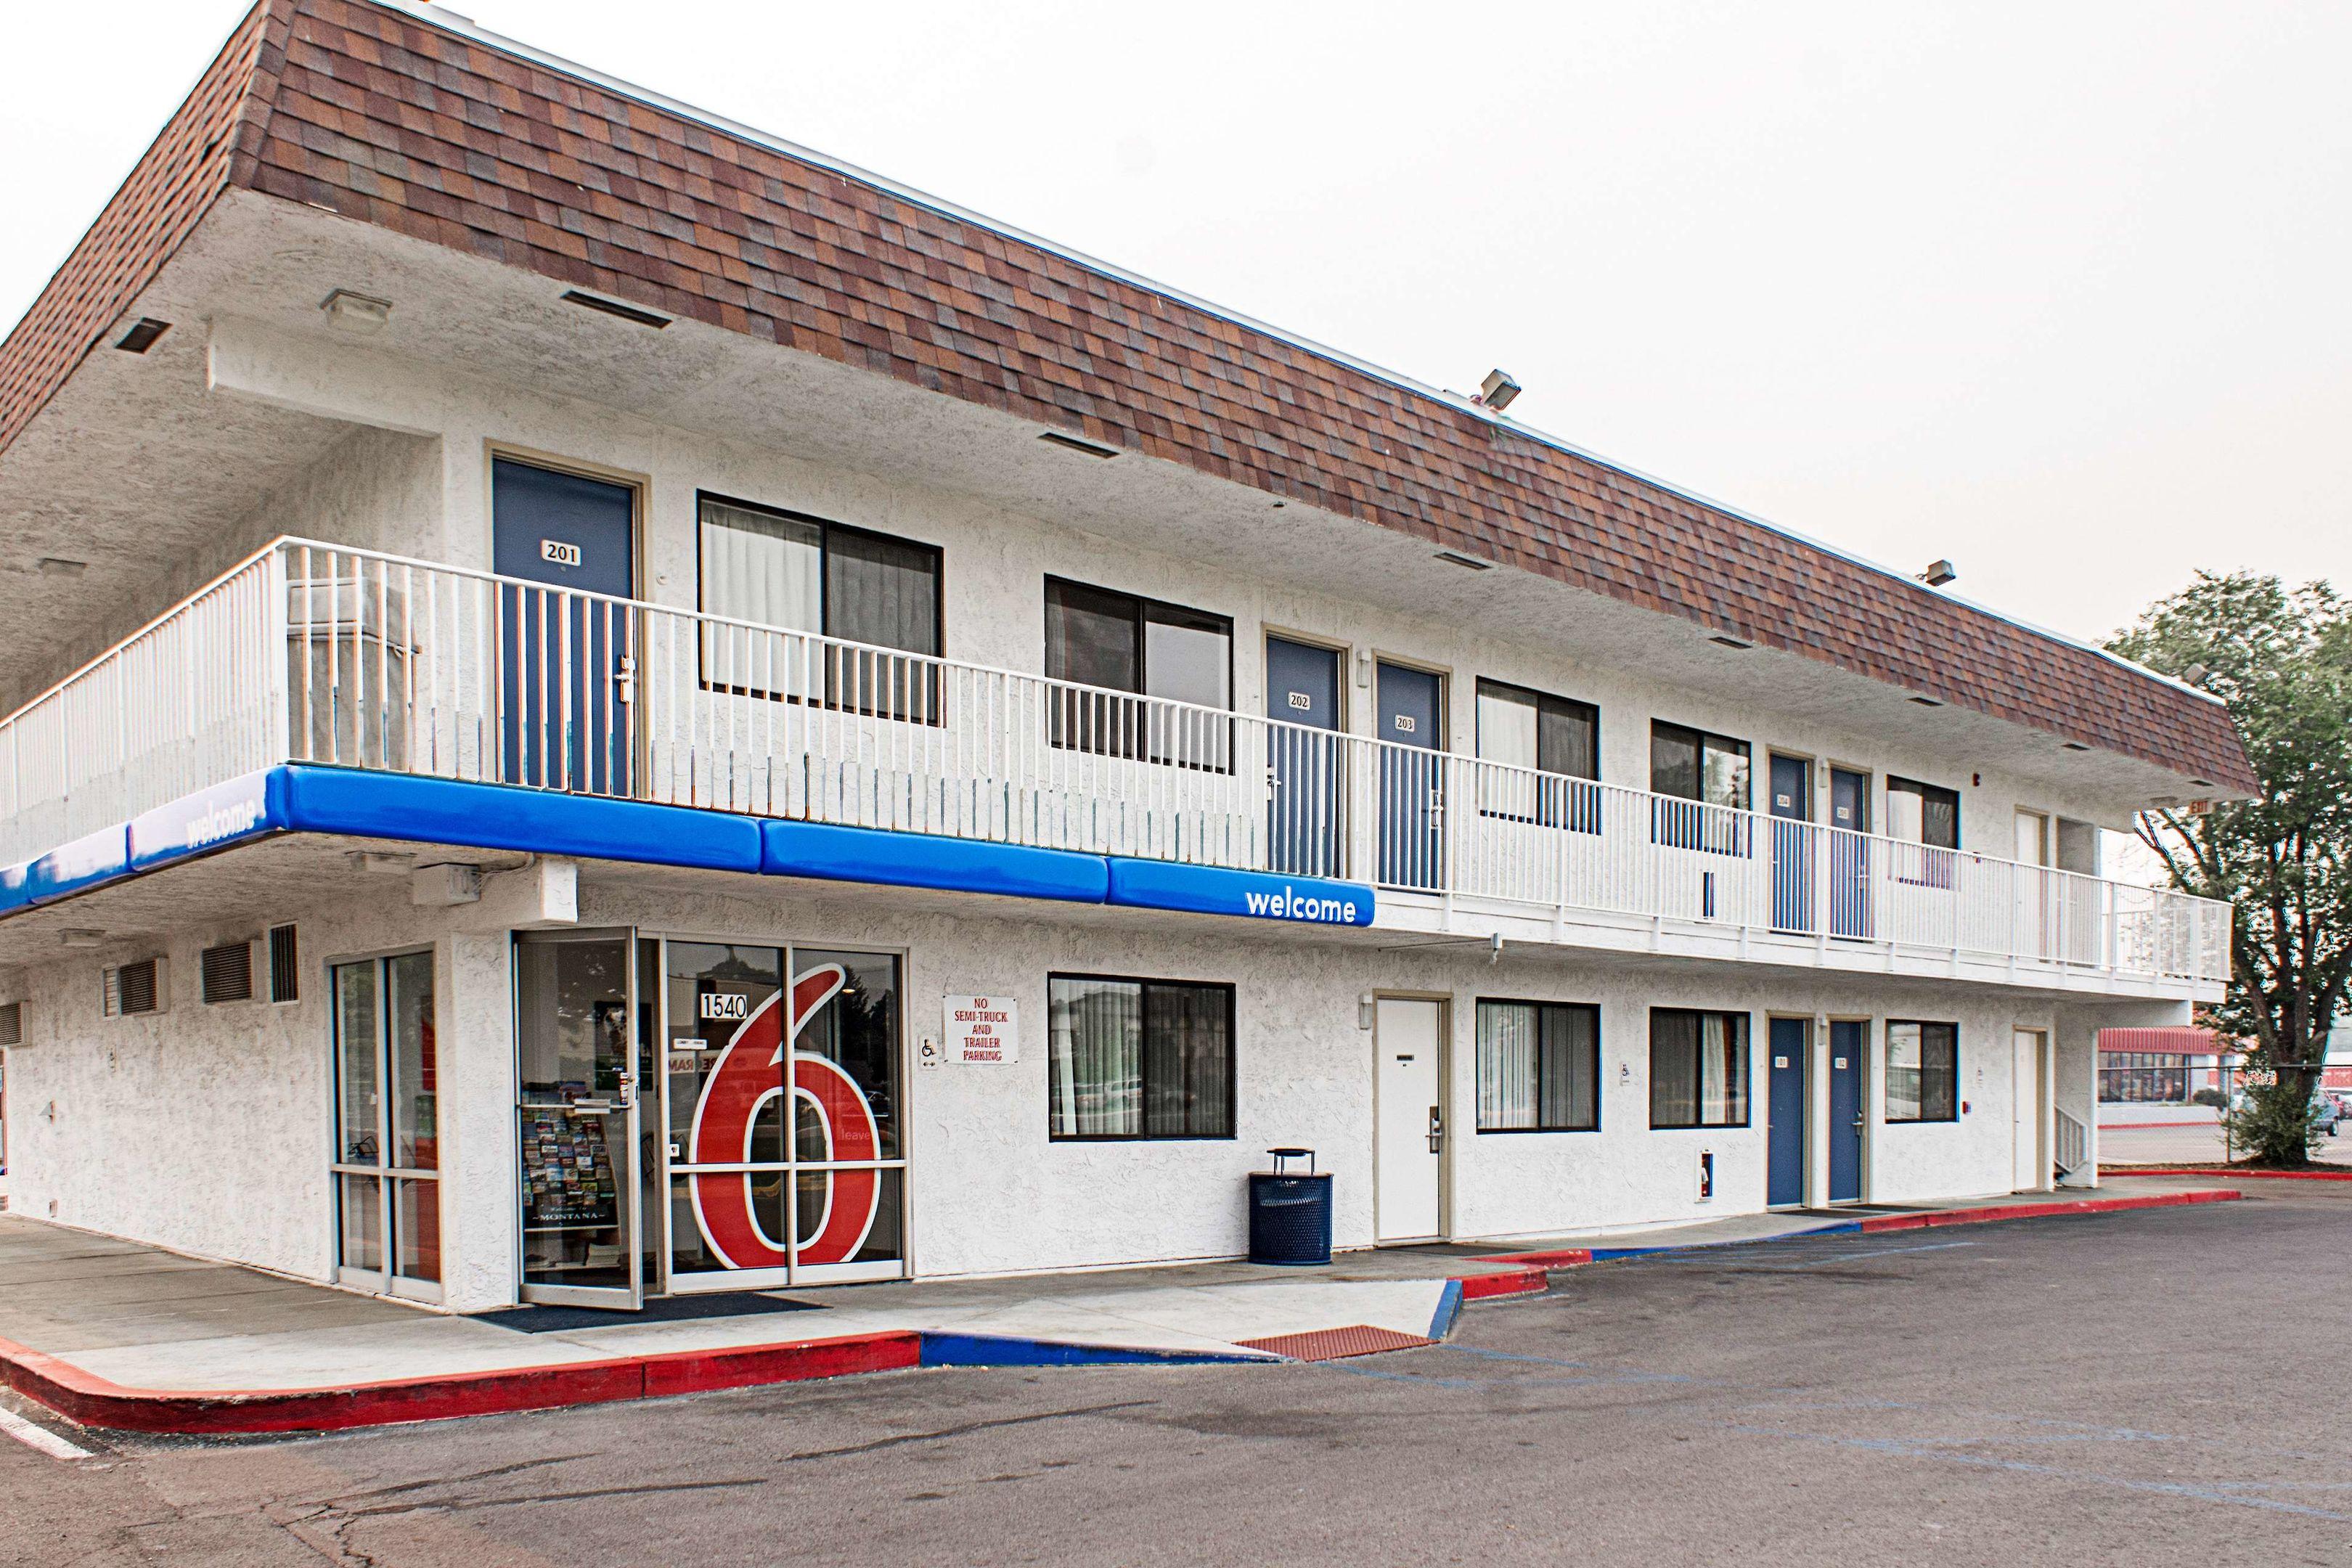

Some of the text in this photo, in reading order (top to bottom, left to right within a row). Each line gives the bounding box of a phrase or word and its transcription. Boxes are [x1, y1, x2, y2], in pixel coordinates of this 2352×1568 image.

[547, 544, 576, 563] 201
[1291, 694, 1307, 708] 202
[1397, 717, 1412, 730] 203
[186, 799, 256, 849] welcome
[1246, 886, 1357, 923] welcome
[703, 995, 746, 1018] 1540
[974, 998, 988, 1009] NO
[955, 1010, 1008, 1022] SEMI-TRUCK
[972, 1024, 992, 1035] AND
[963, 1037, 1001, 1048] TRAILER
[963, 1050, 1003, 1061] PARKING
[841, 1128, 870, 1140] leave
[540, 1212, 597, 1221] MONTANA
